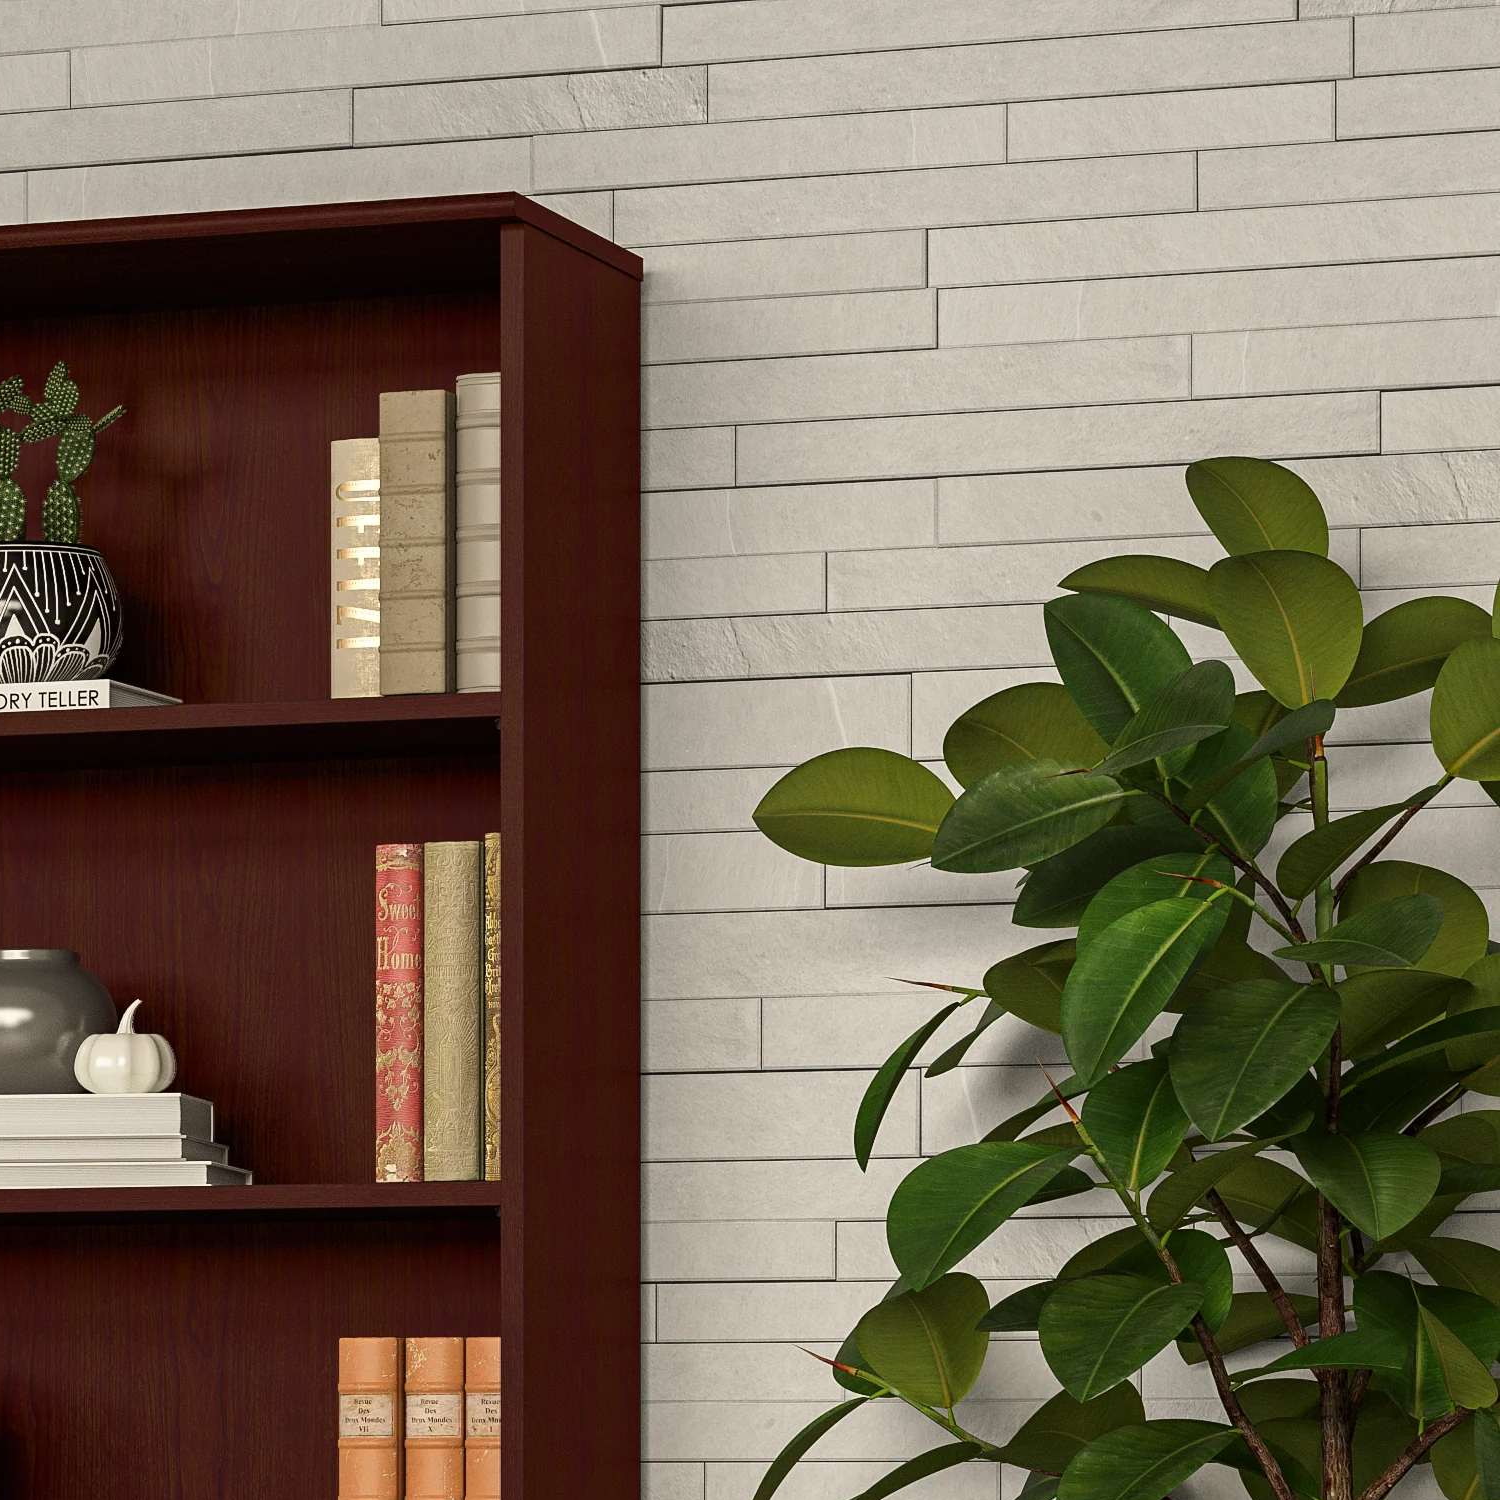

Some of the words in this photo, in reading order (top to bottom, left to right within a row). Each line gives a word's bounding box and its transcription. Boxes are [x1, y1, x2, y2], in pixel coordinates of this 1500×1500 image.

[38, 689, 99, 709] TELLER
[377, 883, 421, 921] Sweet
[376, 927, 422, 970] Home
